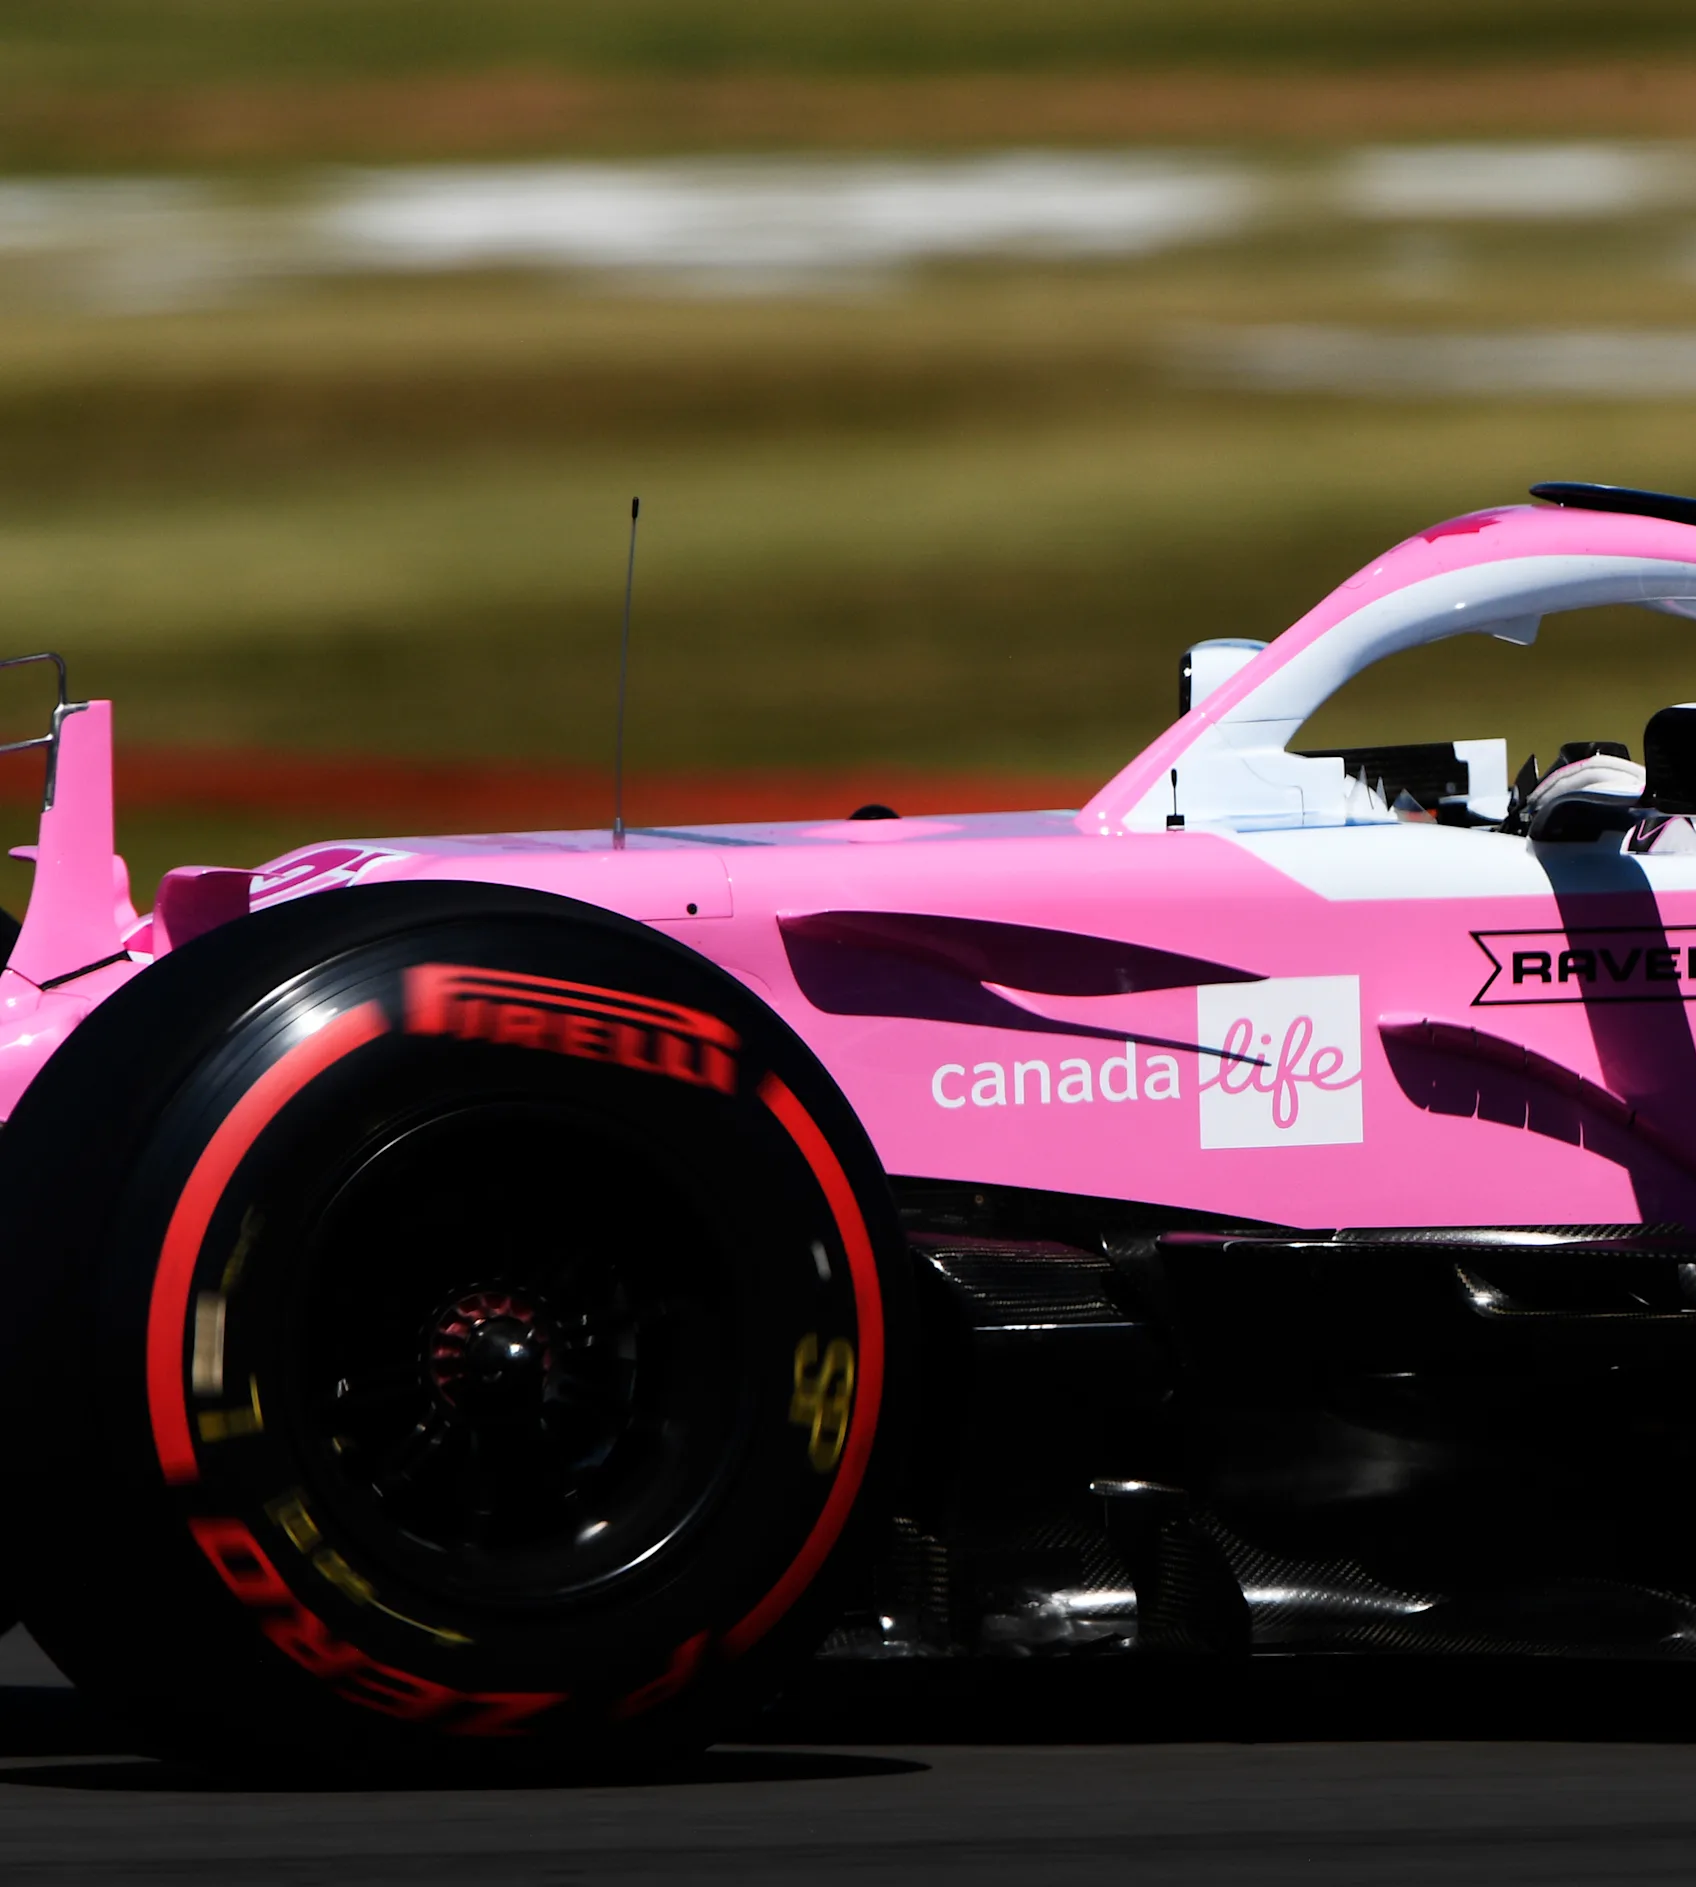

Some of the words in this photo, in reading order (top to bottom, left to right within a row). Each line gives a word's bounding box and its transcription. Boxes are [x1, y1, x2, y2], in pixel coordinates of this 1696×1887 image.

[403, 962, 742, 1097] PIRELLI
[930, 1036, 1182, 1110] canada
[1198, 1015, 1363, 1130] life
[187, 1515, 574, 1738] ZERO
